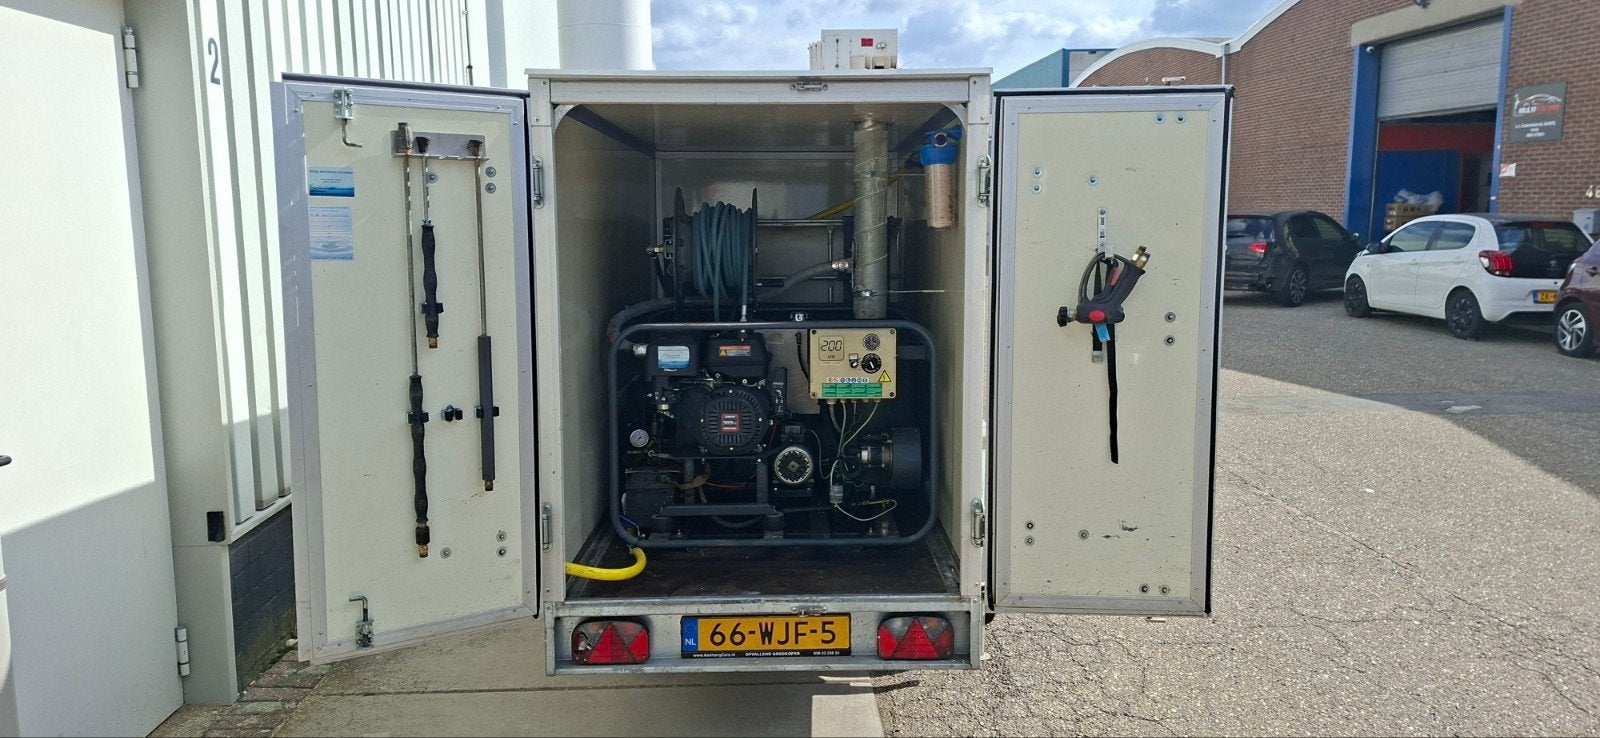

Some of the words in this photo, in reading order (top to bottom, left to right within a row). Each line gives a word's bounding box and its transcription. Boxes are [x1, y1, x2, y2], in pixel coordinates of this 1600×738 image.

[208, 37, 221, 85] 2
[820, 340, 843, 352] 200
[685, 638, 697, 646] NL
[709, 621, 836, 647] 66-WJF-5
